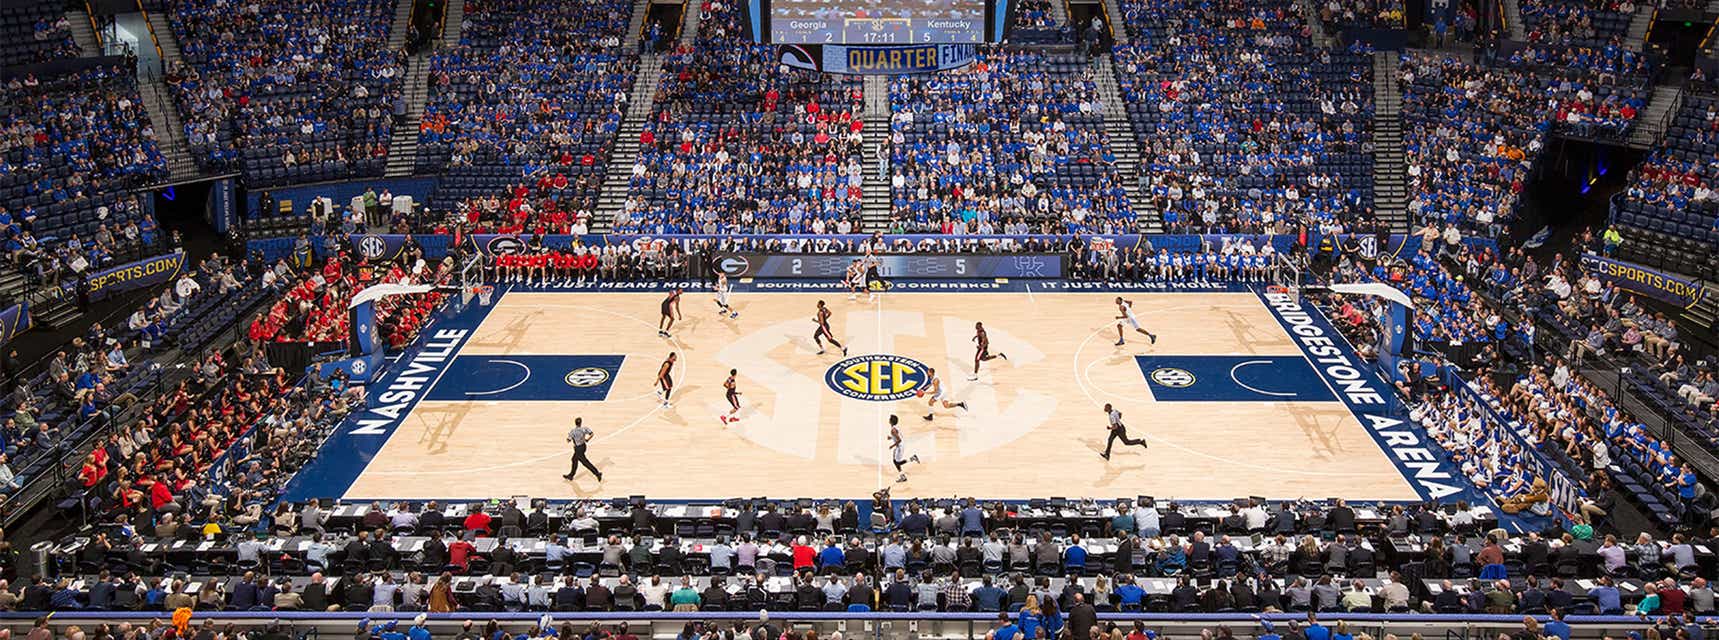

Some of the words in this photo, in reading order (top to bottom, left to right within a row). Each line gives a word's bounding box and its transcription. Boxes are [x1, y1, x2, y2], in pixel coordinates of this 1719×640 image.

[790, 21, 827, 30] Georgia
[927, 20, 971, 30] Kentucky
[825, 32, 833, 42] 2
[863, 32, 895, 43] 17:11
[923, 32, 931, 42] 5
[849, 47, 937, 72] QUARTER
[361, 236, 384, 258] SEC
[89, 257, 178, 292] SPORTS.COM
[791, 258, 802, 275] 2
[955, 258, 966, 275] 5
[552, 281, 595, 289] JUST
[600, 281, 659, 289] MEANS
[1042, 281, 1058, 289] IT
[1061, 281, 1101, 289] JUST
[1108, 281, 1167, 289] MEANS
[840, 354, 921, 369] SOUTHEASTERN
[348, 328, 469, 435] NASHVILLE
[842, 361, 918, 395] SEC
[1263, 293, 1386, 405] BRIDGESTONE
[1364, 413, 1463, 499] ARENA
